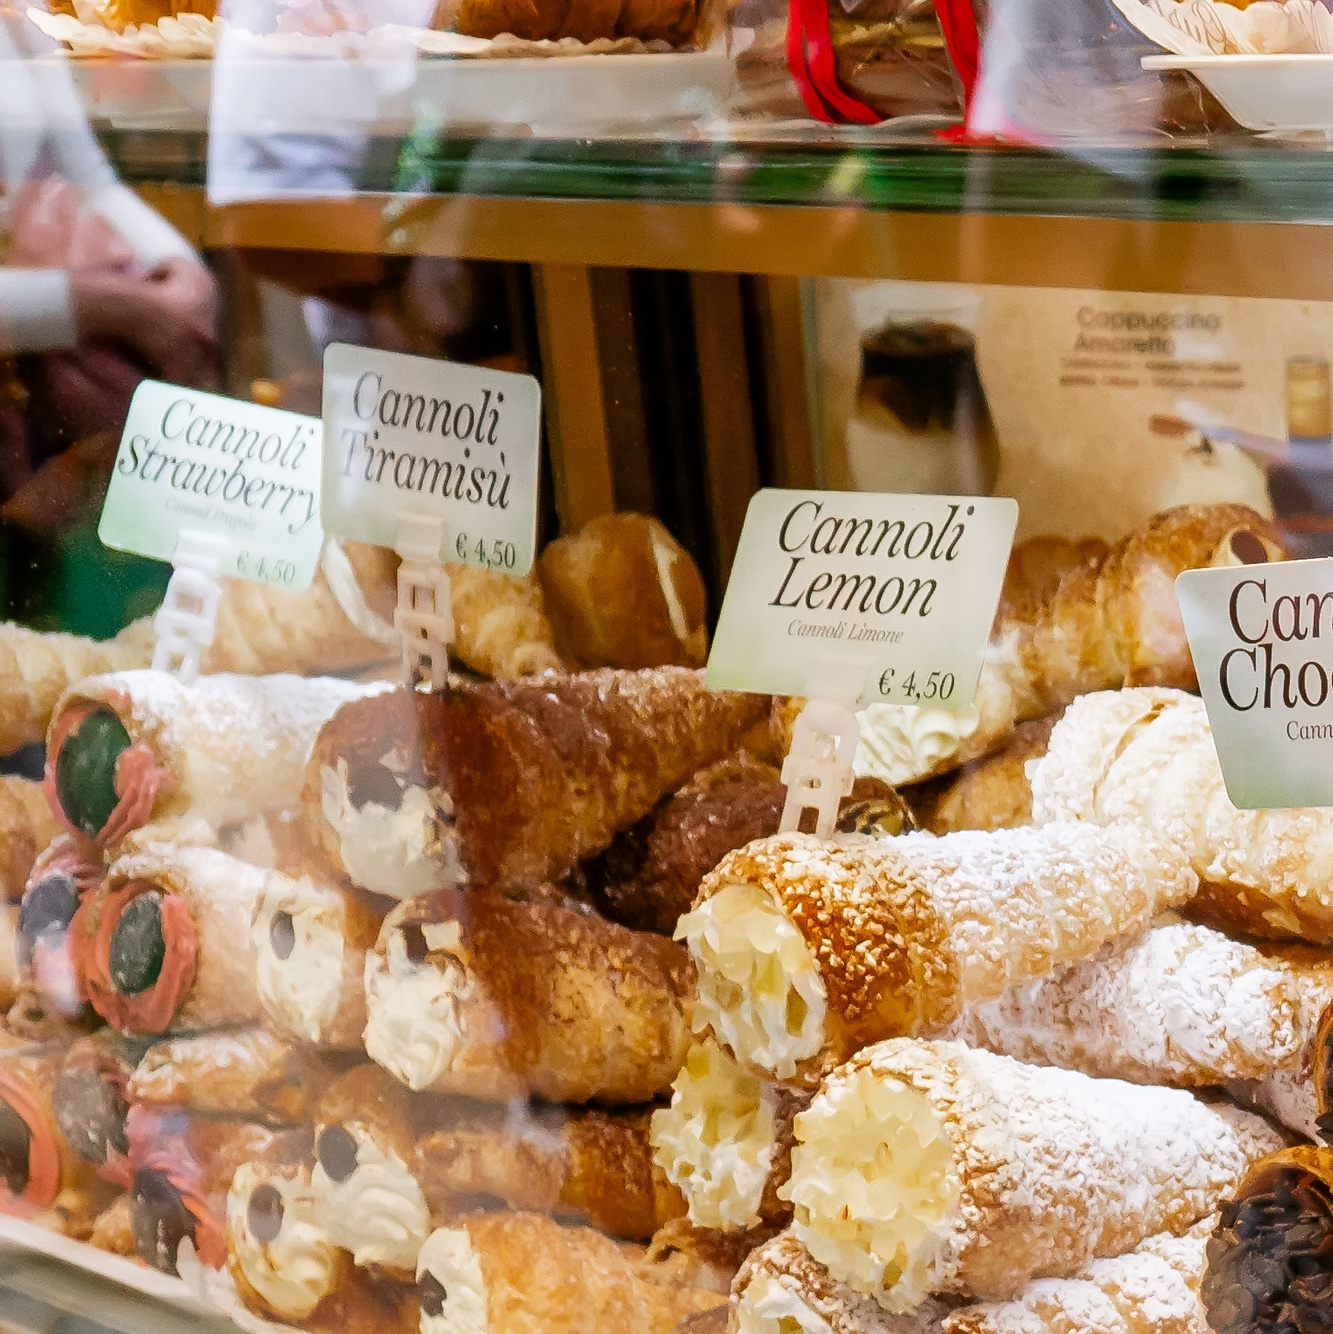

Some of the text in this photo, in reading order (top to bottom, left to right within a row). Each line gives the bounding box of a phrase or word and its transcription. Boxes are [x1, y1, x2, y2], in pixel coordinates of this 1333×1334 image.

[160, 398, 315, 470] Cannoli
[353, 370, 504, 446] Cannoli
[117, 434, 318, 535] Strawberry
[340, 428, 511, 510] Tiramisù
[456, 532, 516, 570] € 4,50
[778, 500, 975, 562] Cannoli
[236, 551, 296, 585] € 4,50
[767, 556, 938, 618] Lemon
[787, 618, 905, 644] Cannoli Limone
[878, 667, 956, 703] € 4,50
